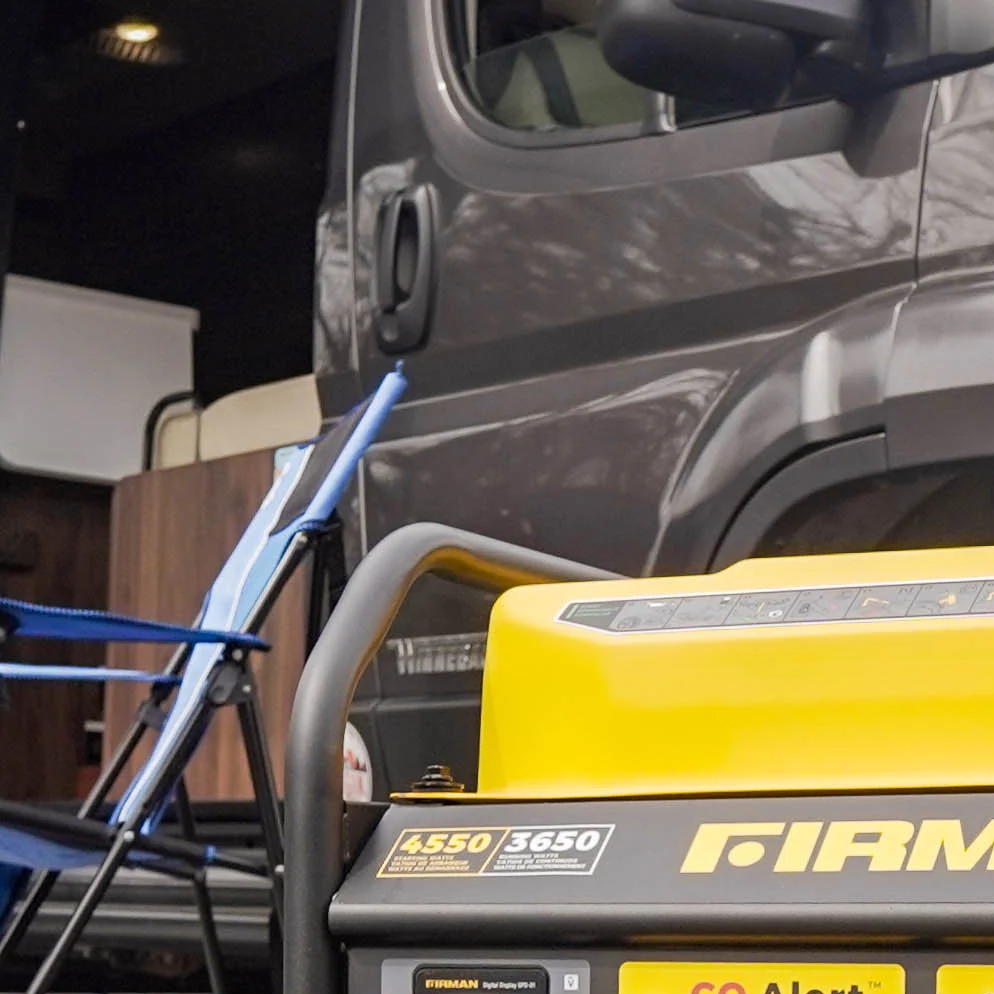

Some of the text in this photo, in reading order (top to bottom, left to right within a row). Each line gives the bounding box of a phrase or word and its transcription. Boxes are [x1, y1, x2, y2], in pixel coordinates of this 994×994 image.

[400, 832, 492, 854] 4550
[504, 830, 600, 853] 3650
[425, 979, 479, 989] FIRMAN
